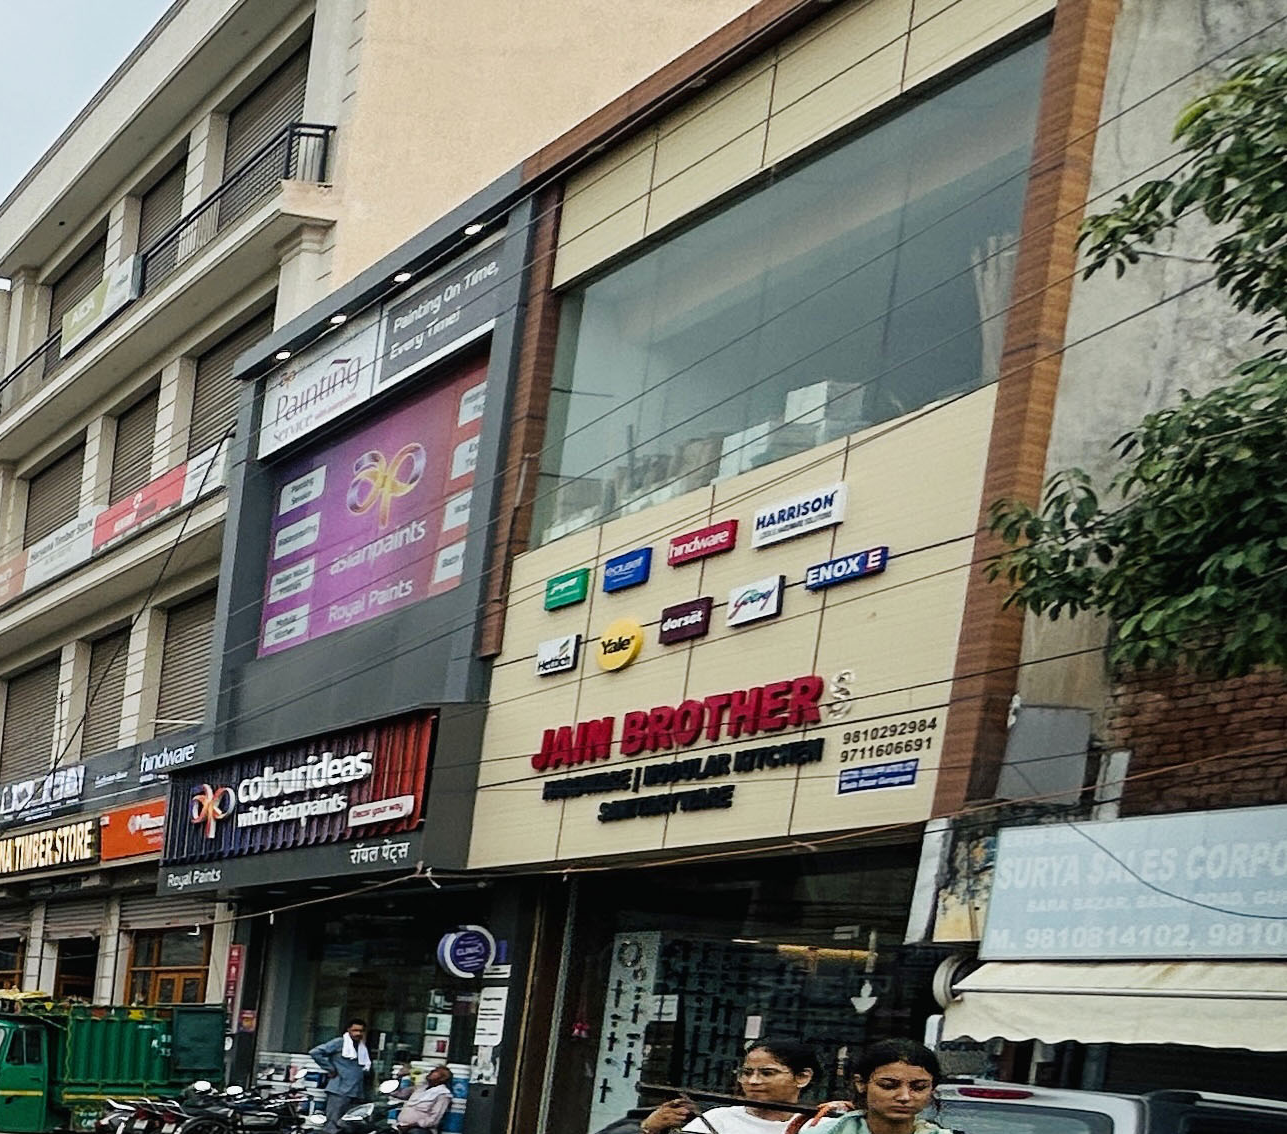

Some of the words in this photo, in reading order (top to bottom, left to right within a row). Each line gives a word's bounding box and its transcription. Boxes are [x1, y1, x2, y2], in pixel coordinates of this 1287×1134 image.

[394, 295, 441, 334] Painting
[442, 284, 460, 302] On
[463, 260, 501, 289] Time,
[389, 333, 424, 361] Every
[276, 357, 363, 428] Painting
[755, 490, 835, 532] HARRISON
[329, 518, 427, 576] asianpaints
[668, 528, 730, 560] hindware
[805, 555, 860, 588] ENOX
[327, 597, 366, 623] Royal
[368, 577, 414, 609] Paints
[601, 636, 631, 656] Yale
[531, 715, 615, 773] JAIN
[842, 716, 938, 746] 9810292984
[140, 741, 196, 774] hindware
[732, 737, 826, 774] KITCHEN
[839, 736, 934, 764] 9711606691
[237, 750, 374, 804] colourideas
[267, 792, 348, 829] asianpaints
[14, 829, 56, 872] TIMBER
[56, 820, 94, 865] STORE
[167, 871, 192, 890] Royal
[192, 867, 223, 884] Paints
[994, 855, 1078, 890] SURYA
[1086, 846, 1179, 885] SALES
[1026, 922, 1197, 950] 9810814102,
